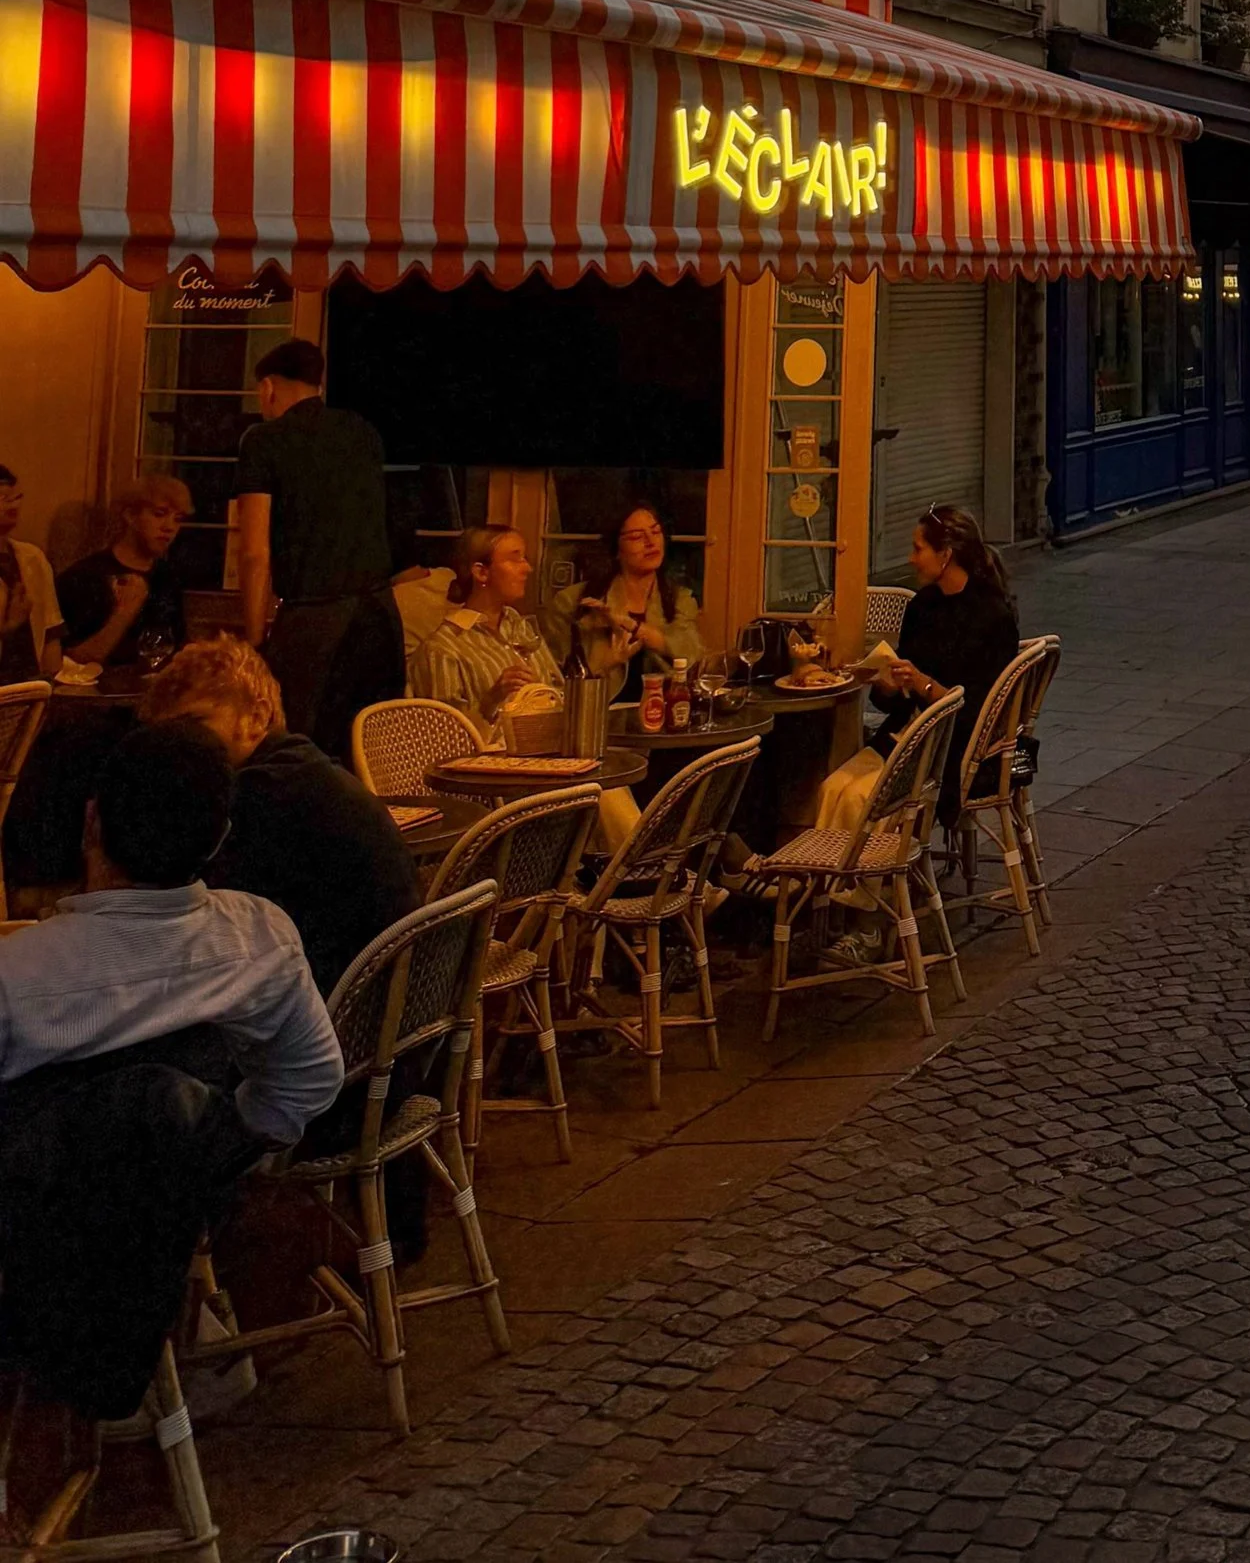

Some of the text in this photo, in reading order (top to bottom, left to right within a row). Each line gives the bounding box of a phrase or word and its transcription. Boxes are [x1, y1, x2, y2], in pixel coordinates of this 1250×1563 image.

[675, 104, 888, 218] L'ÉCLAIR!
[173, 289, 276, 309] du moment
